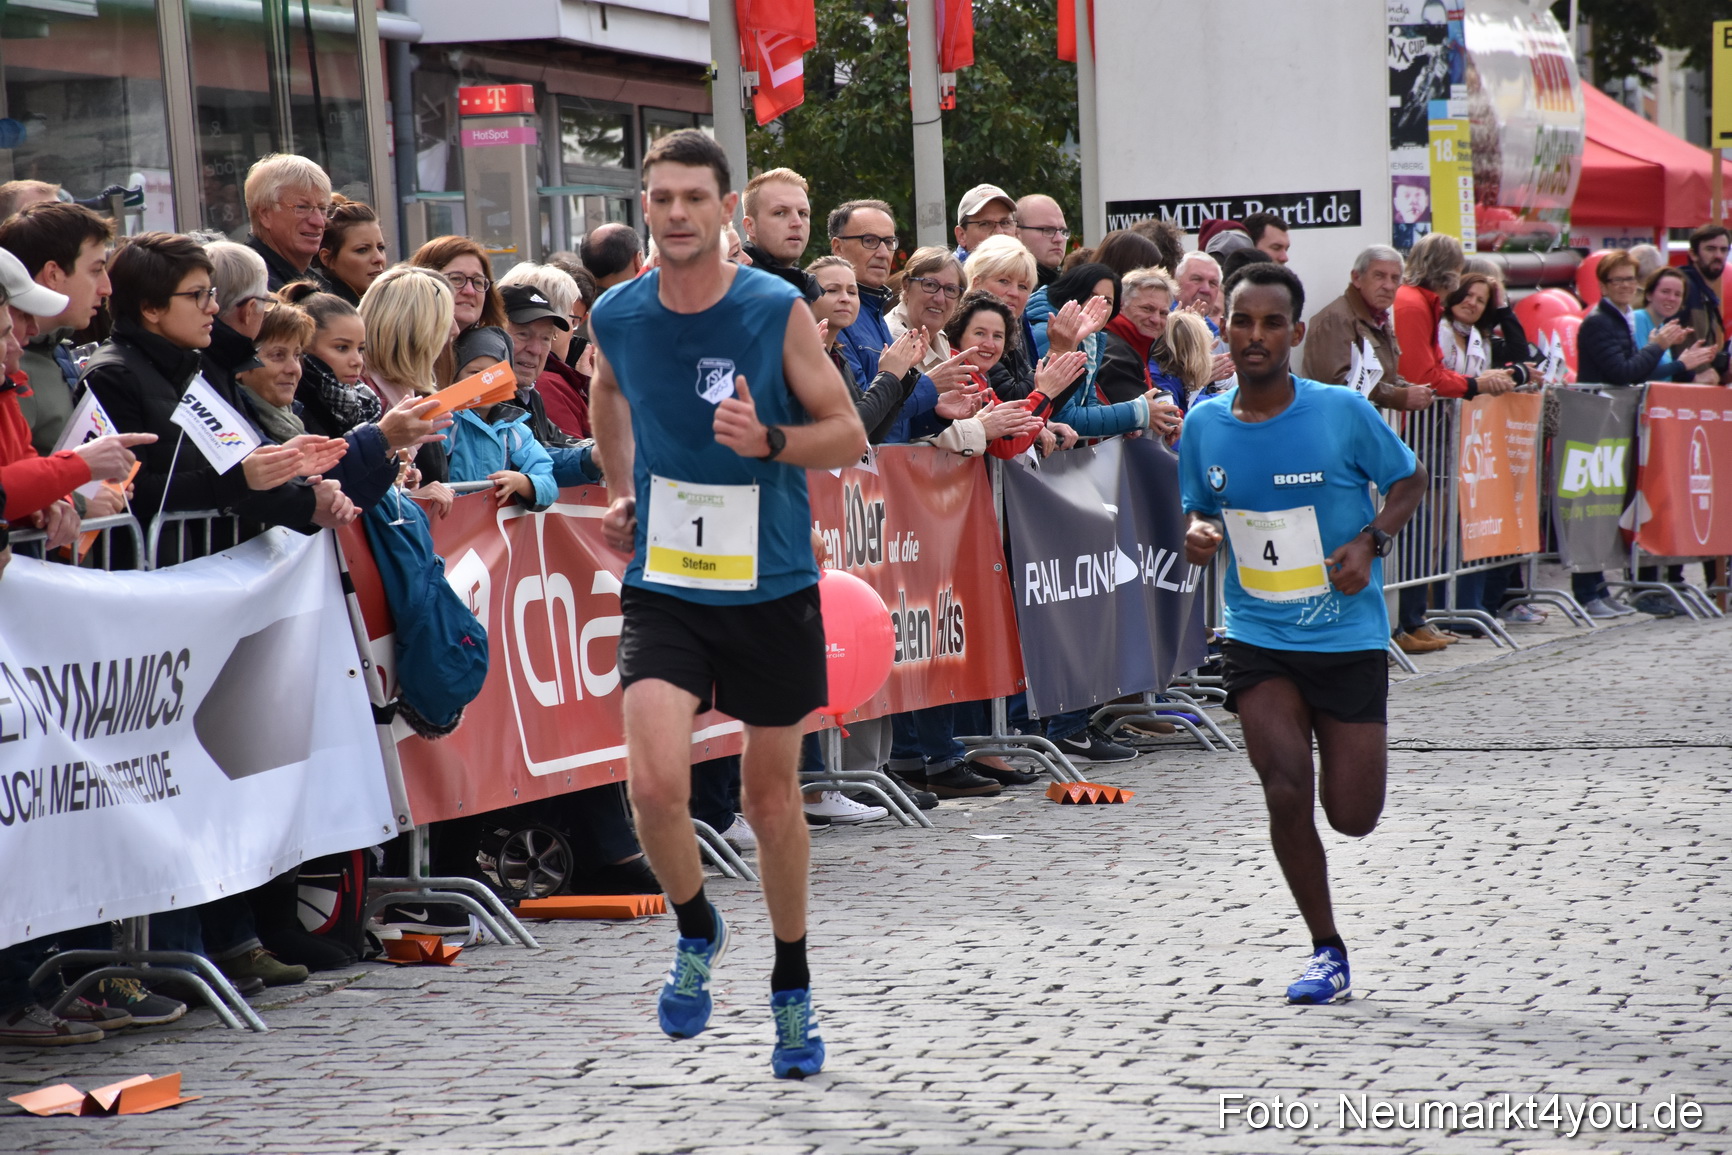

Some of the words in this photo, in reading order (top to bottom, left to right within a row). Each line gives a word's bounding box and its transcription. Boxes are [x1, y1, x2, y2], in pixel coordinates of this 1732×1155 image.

[487, 88, 506, 111] T
[473, 130, 509, 141] HotSpot
[1433, 138, 1457, 162] 18.
[1107, 195, 1351, 236] wwwMINI-Bartl.de
[180, 393, 223, 433] swn
[1273, 471, 1324, 485] BOCK
[692, 516, 703, 547] 1
[902, 531, 920, 563] die
[1263, 540, 1278, 566] 4
[682, 556, 717, 571] Stefan
[1025, 550, 1116, 607] RAIL.ONE
[934, 583, 965, 661] Hits
